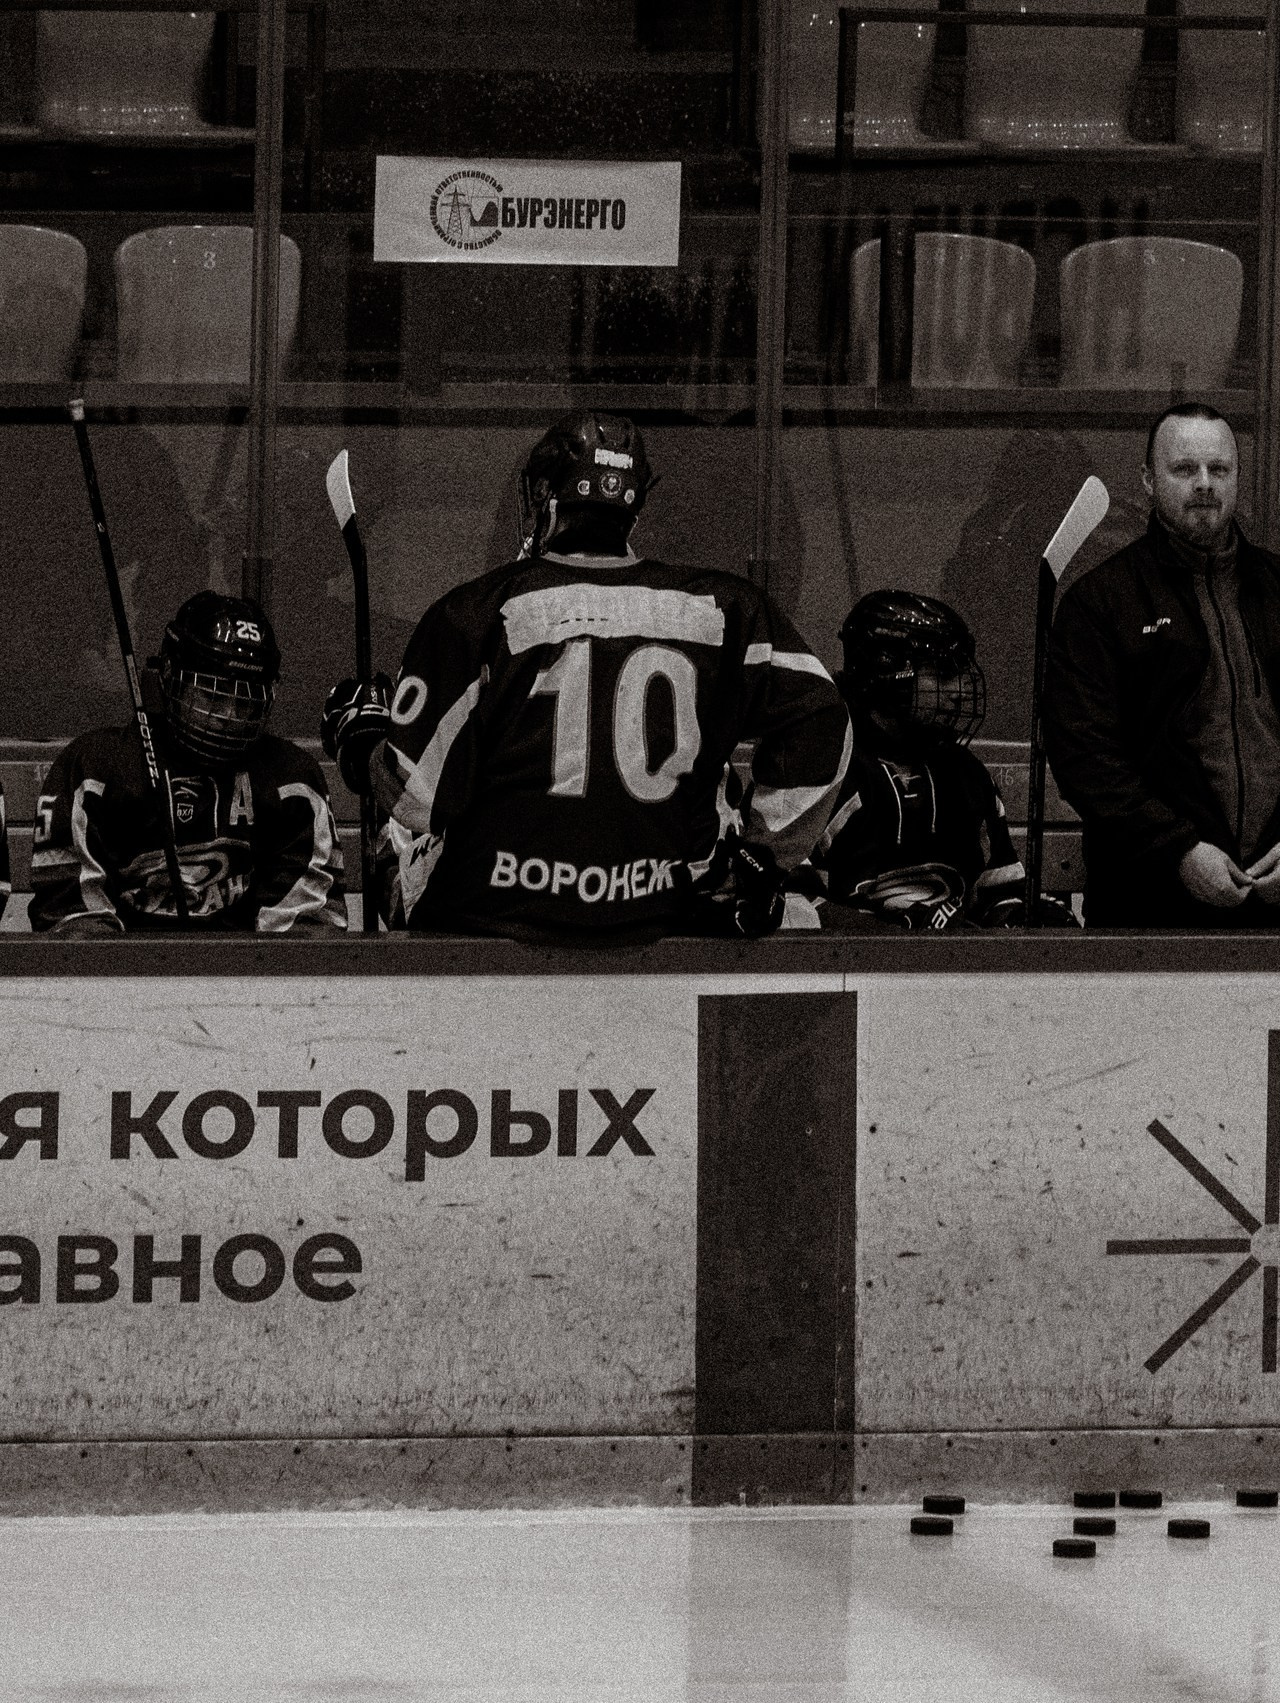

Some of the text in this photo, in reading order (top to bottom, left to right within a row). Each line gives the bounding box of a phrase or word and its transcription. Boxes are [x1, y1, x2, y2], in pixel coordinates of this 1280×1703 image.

[501, 197, 626, 231] БУРЭНЕРГО
[236, 620, 262, 642] 25
[527, 637, 701, 803] 10
[489, 850, 683, 903] ВОРОНЕЖ
[739, 848, 765, 873] CCM
[110, 1088, 657, 1182] которых
